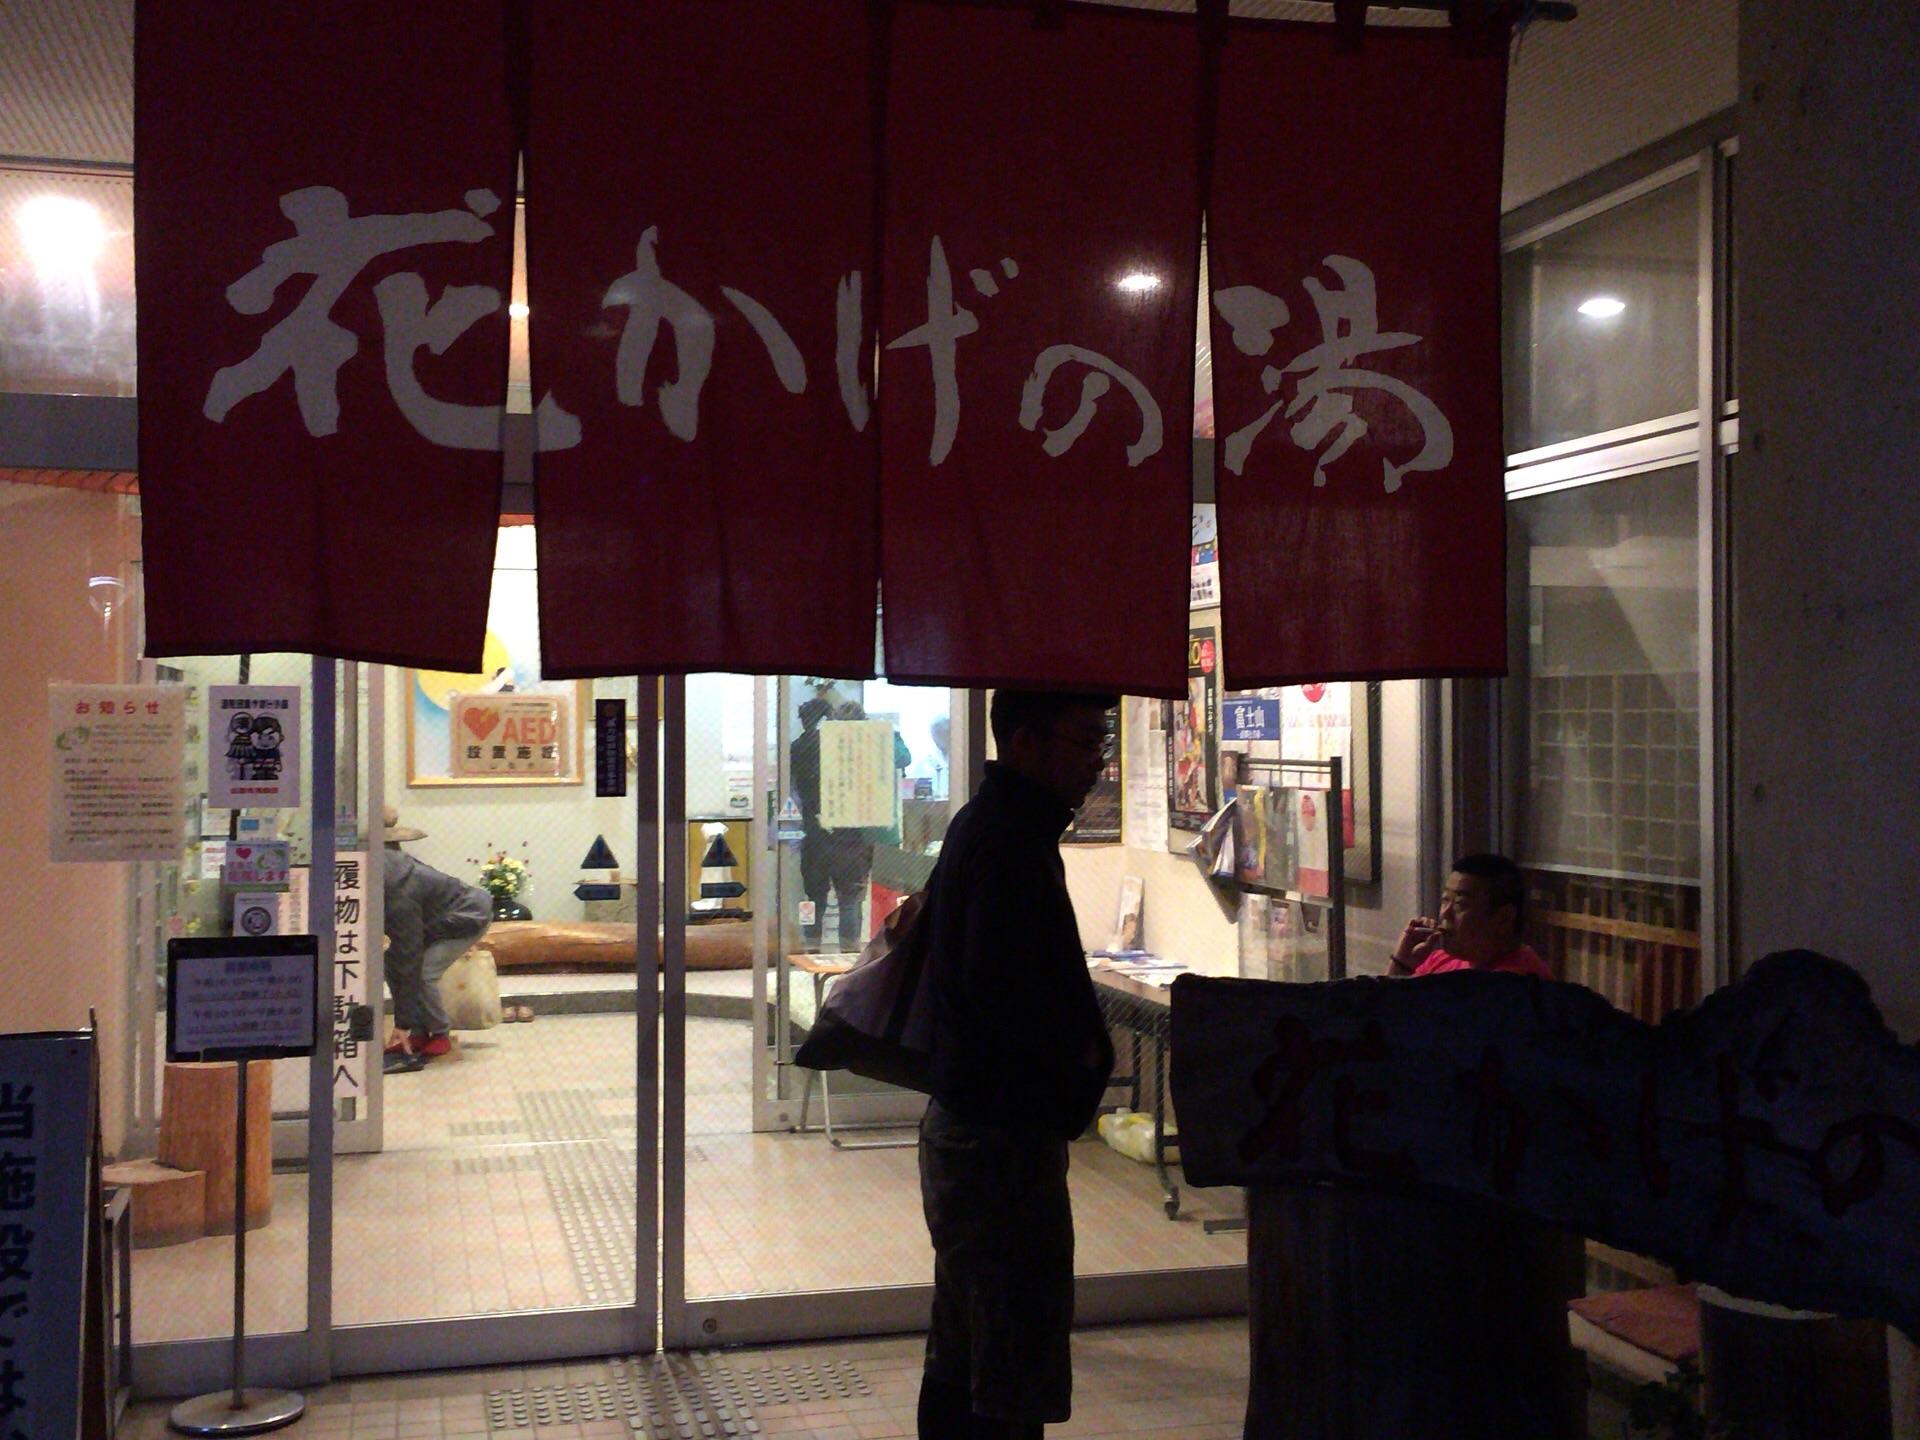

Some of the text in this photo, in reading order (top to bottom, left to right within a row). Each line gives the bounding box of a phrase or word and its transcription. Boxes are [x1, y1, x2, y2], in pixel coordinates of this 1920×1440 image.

[202, 185, 1453, 492] 花かげの湯
[75, 700, 160, 715] お知らせ
[501, 716, 556, 745] AED
